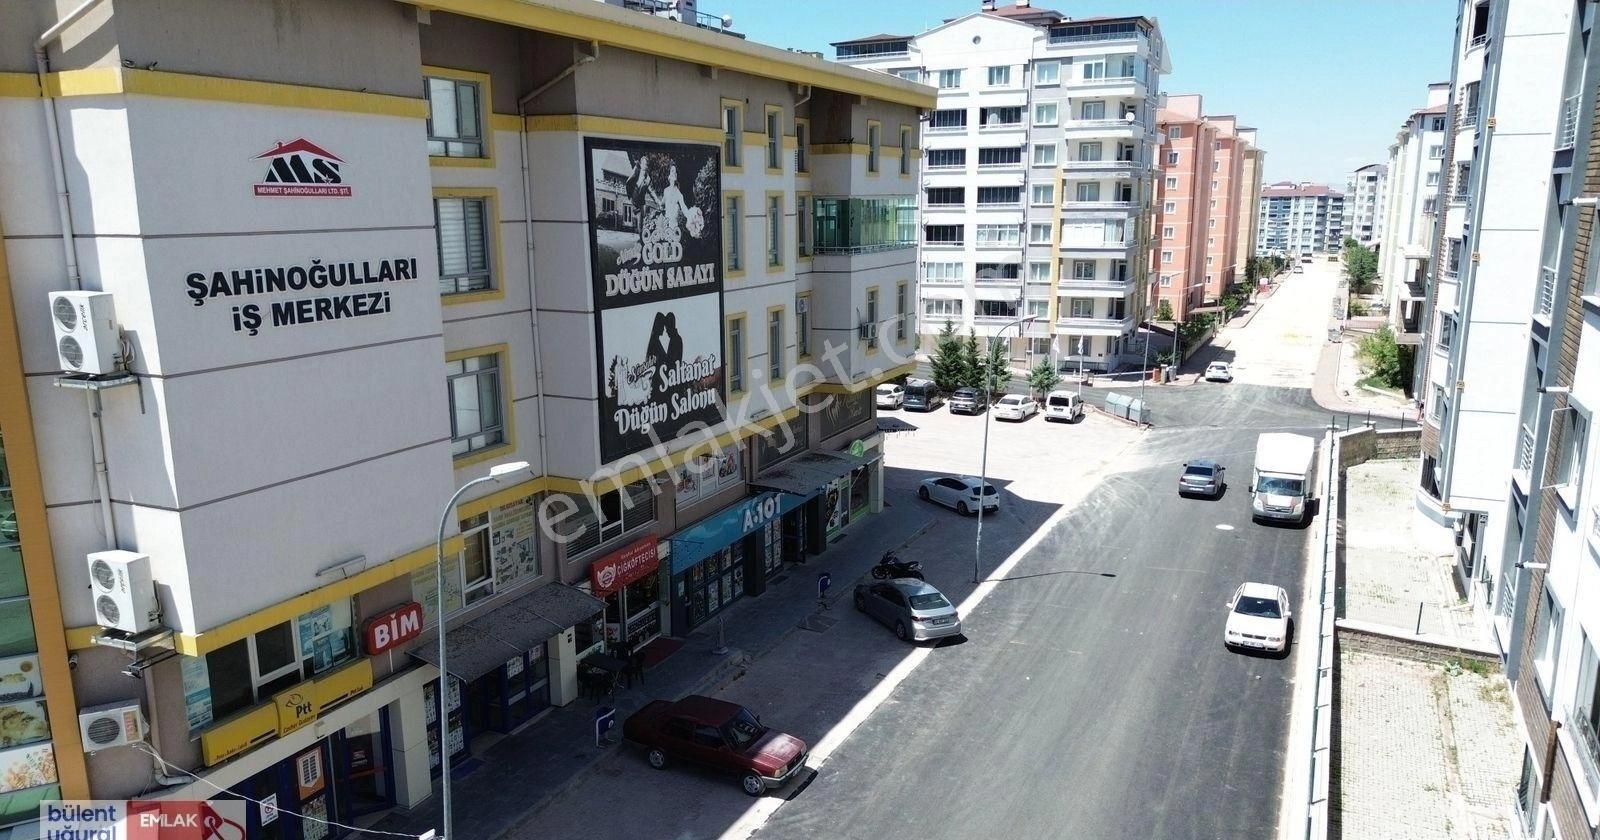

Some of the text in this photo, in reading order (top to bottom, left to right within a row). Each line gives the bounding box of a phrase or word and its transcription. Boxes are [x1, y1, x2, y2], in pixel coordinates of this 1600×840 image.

[257, 186, 282, 194] MEHMET
[641, 242, 683, 265] GOLD
[605, 262, 716, 297] DÜĞÜN SARAYI
[659, 354, 717, 393] Saltanat
[613, 387, 717, 435] Düğün Salonu
[374, 610, 420, 649] BİM
[295, 701, 313, 718] Ptt
